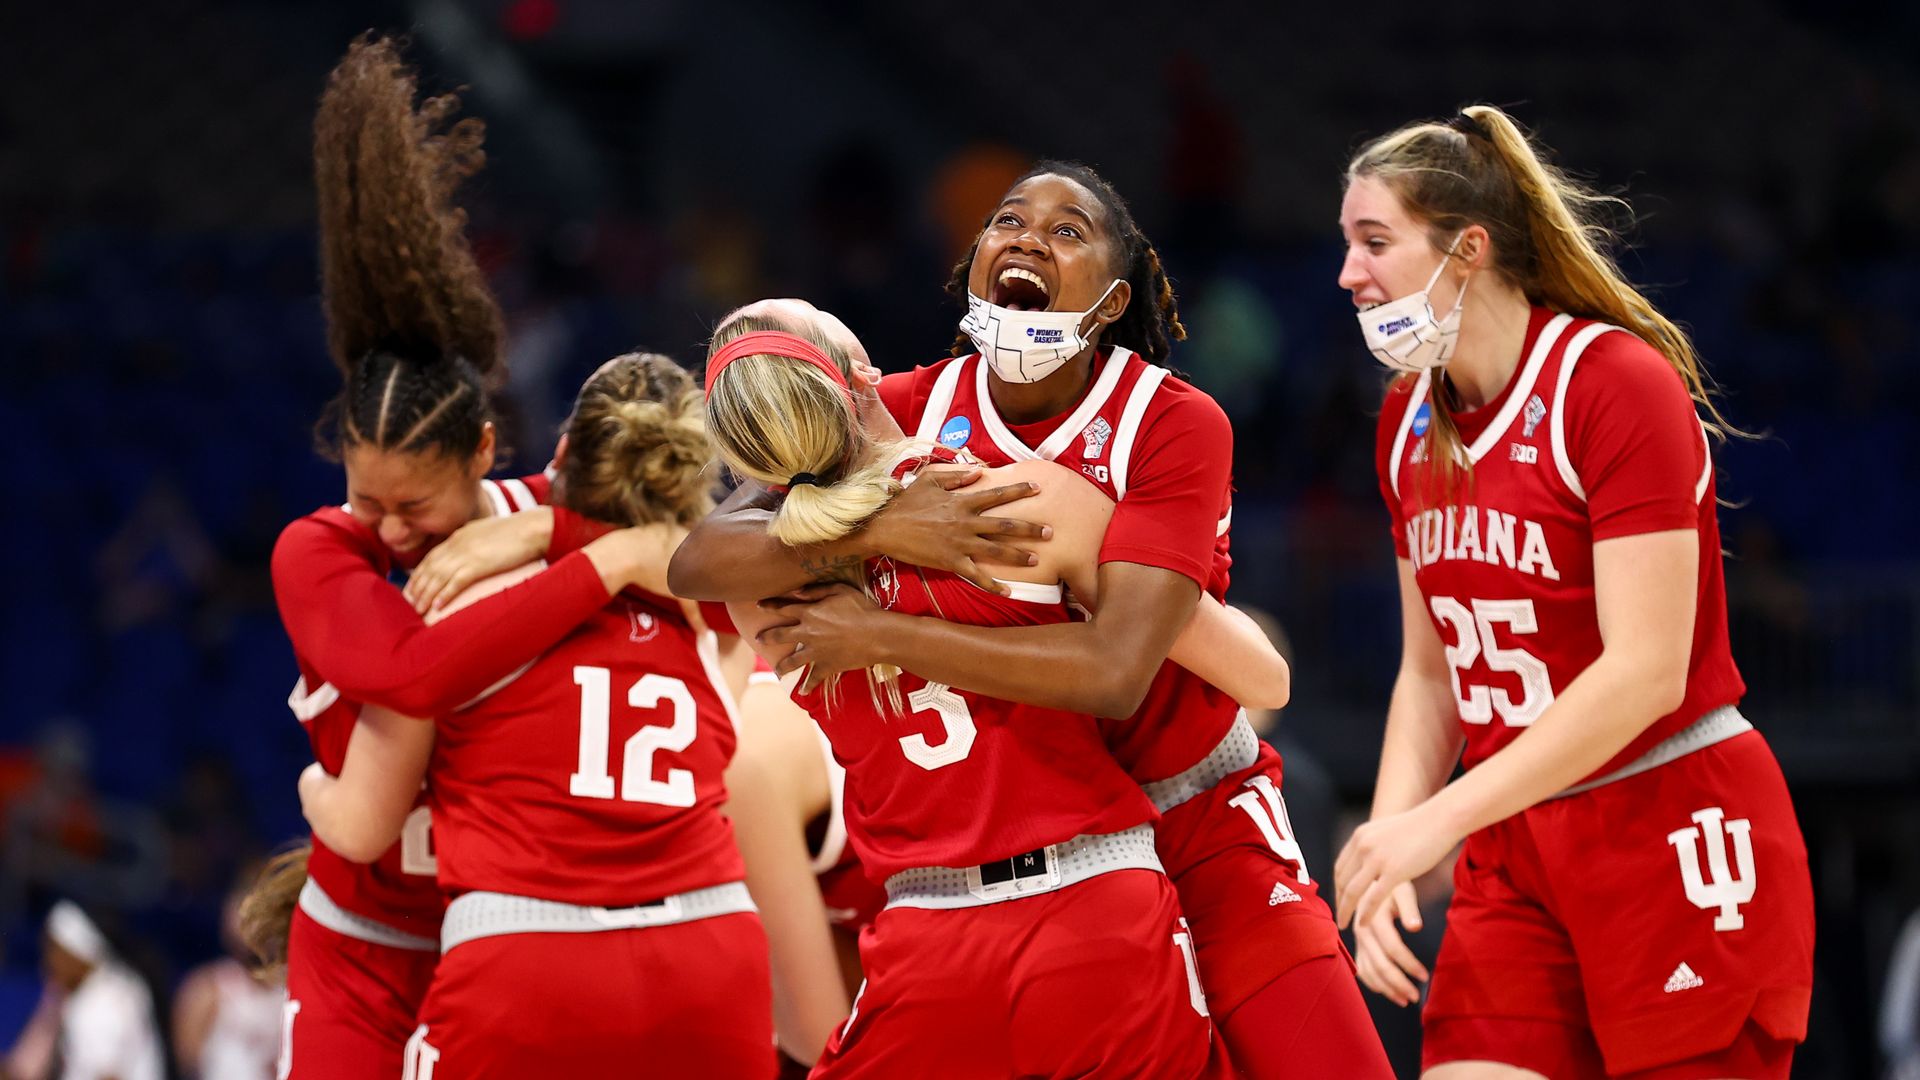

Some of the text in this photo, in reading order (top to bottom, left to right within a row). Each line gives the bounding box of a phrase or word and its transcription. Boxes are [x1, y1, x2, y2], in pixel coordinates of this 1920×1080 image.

[943, 429, 969, 443] NCAA
[1405, 505, 1561, 581] NDIANA
[1430, 595, 1555, 728] 25
[569, 664, 697, 808] 12
[1024, 856, 1035, 868] M
